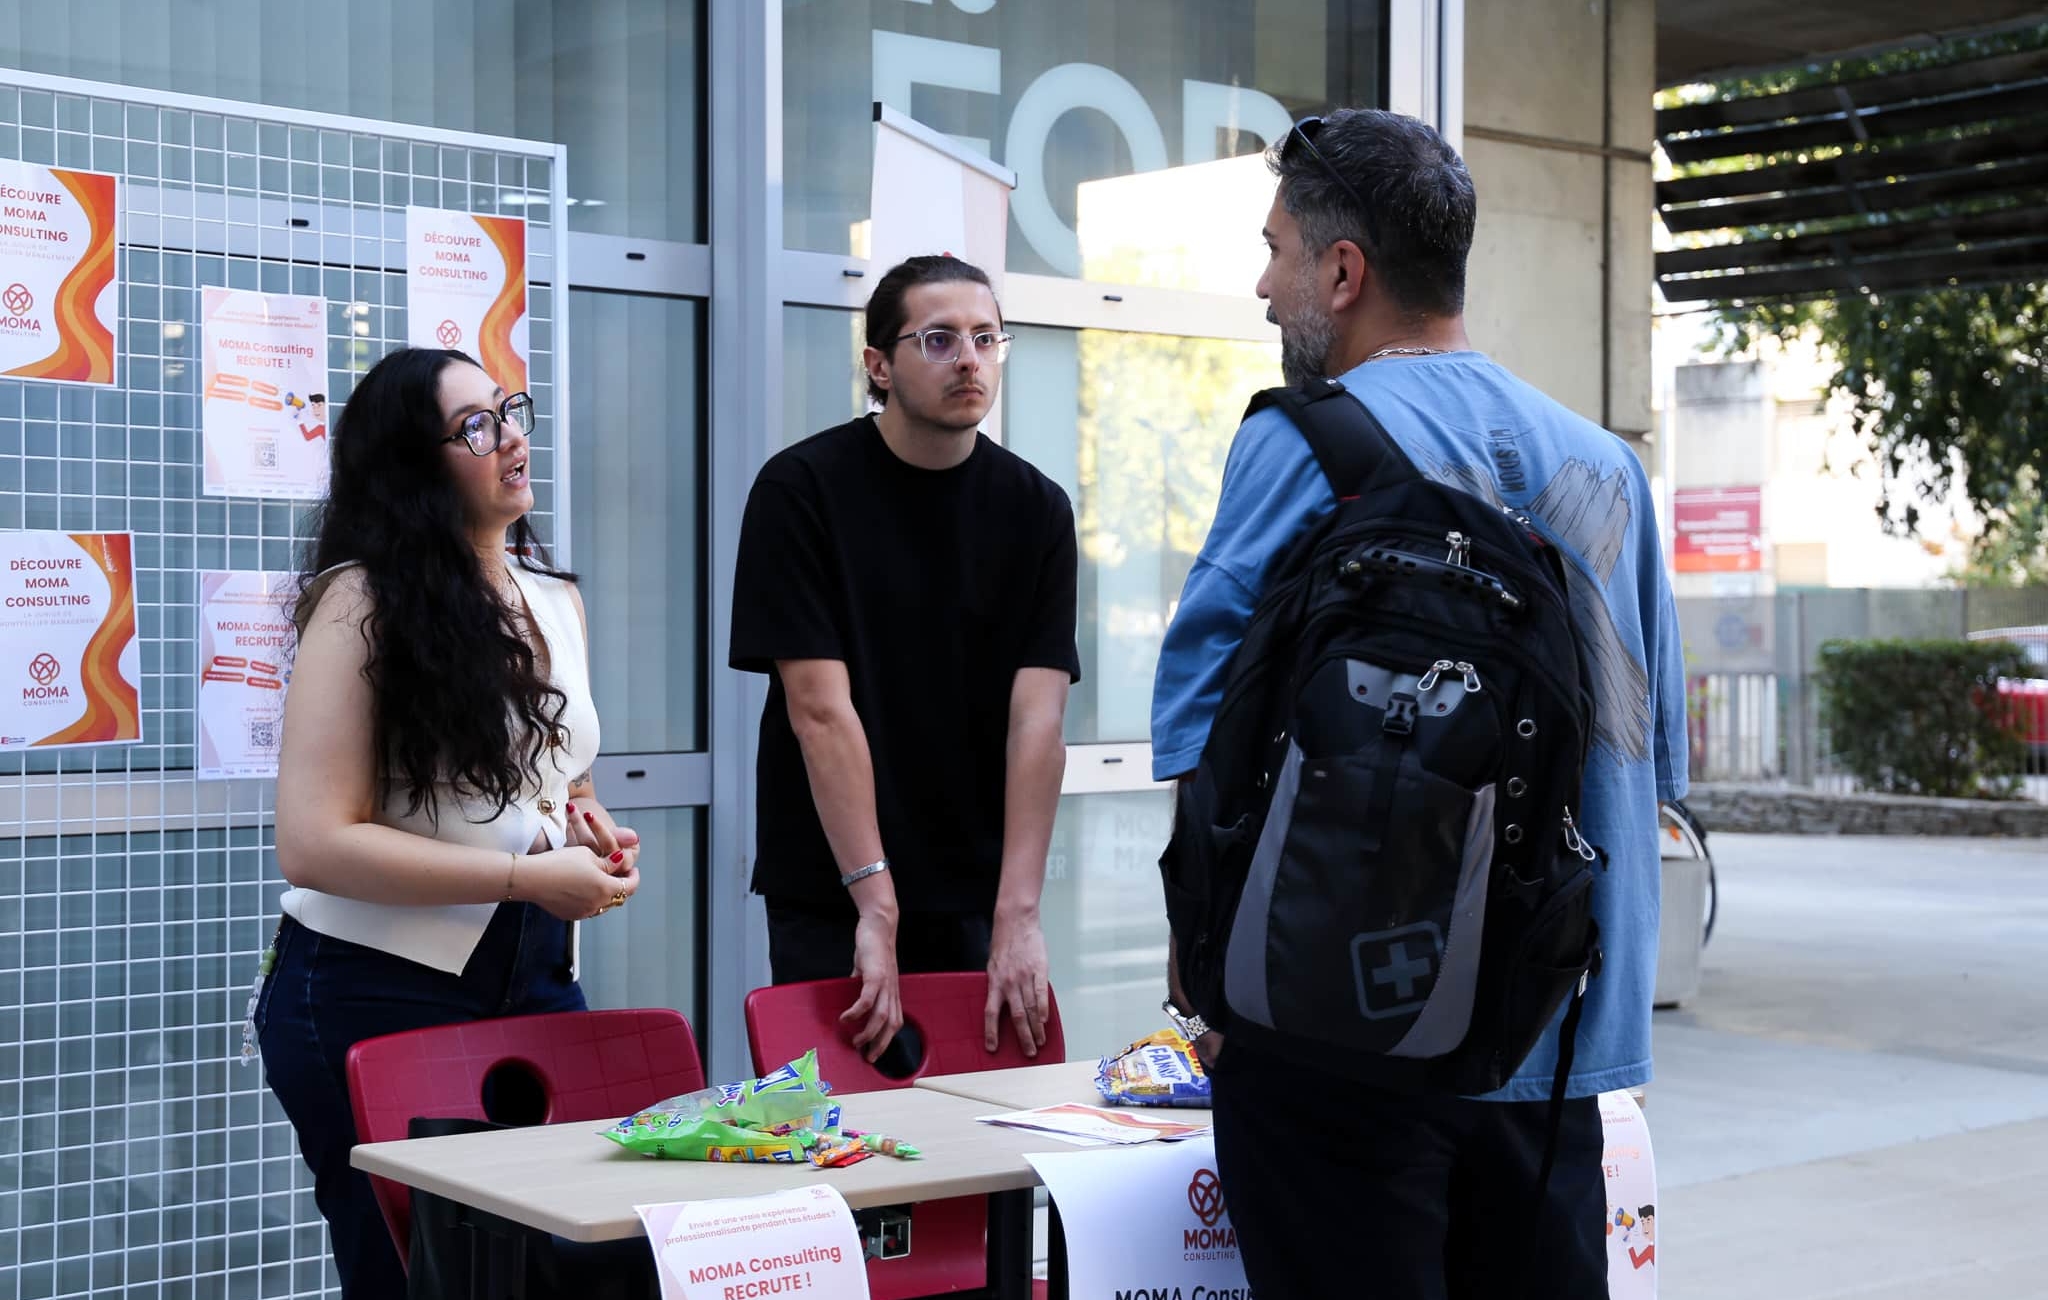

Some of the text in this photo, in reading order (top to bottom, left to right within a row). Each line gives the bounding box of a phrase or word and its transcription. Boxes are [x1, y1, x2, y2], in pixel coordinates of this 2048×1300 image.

[0, 184, 62, 204] ÉCOUVRE
[4, 206, 47, 222] MOMA
[0, 223, 69, 242] NSULTING
[424, 231, 481, 247] DÉCOUVRE
[435, 251, 471, 263] MOMA
[419, 266, 488, 281] CONSULTING
[218, 338, 314, 358] MOMA Consulting
[236, 355, 285, 368] RECRUTE
[10, 557, 82, 571] DÉCOUVRE
[25, 577, 70, 588] MOMA
[5, 595, 91, 607] CONSULTING
[217, 622, 250, 631] MOMA
[235, 636, 284, 647] RECRUTE
[23, 686, 69, 699] MOMA
[688, 1206, 808, 1230] Envie d'une vraie expérience
[665, 1224, 751, 1247] professionnalisante
[752, 1218, 788, 1232] pendant
[789, 1214, 802, 1224] tes
[803, 1209, 832, 1221] études
[1184, 1229, 1236, 1250] MOMA
[1183, 1251, 1236, 1261] CONSULTING
[689, 1246, 842, 1284] MOMA Consulting
[723, 1271, 812, 1300] RECRUTE !
